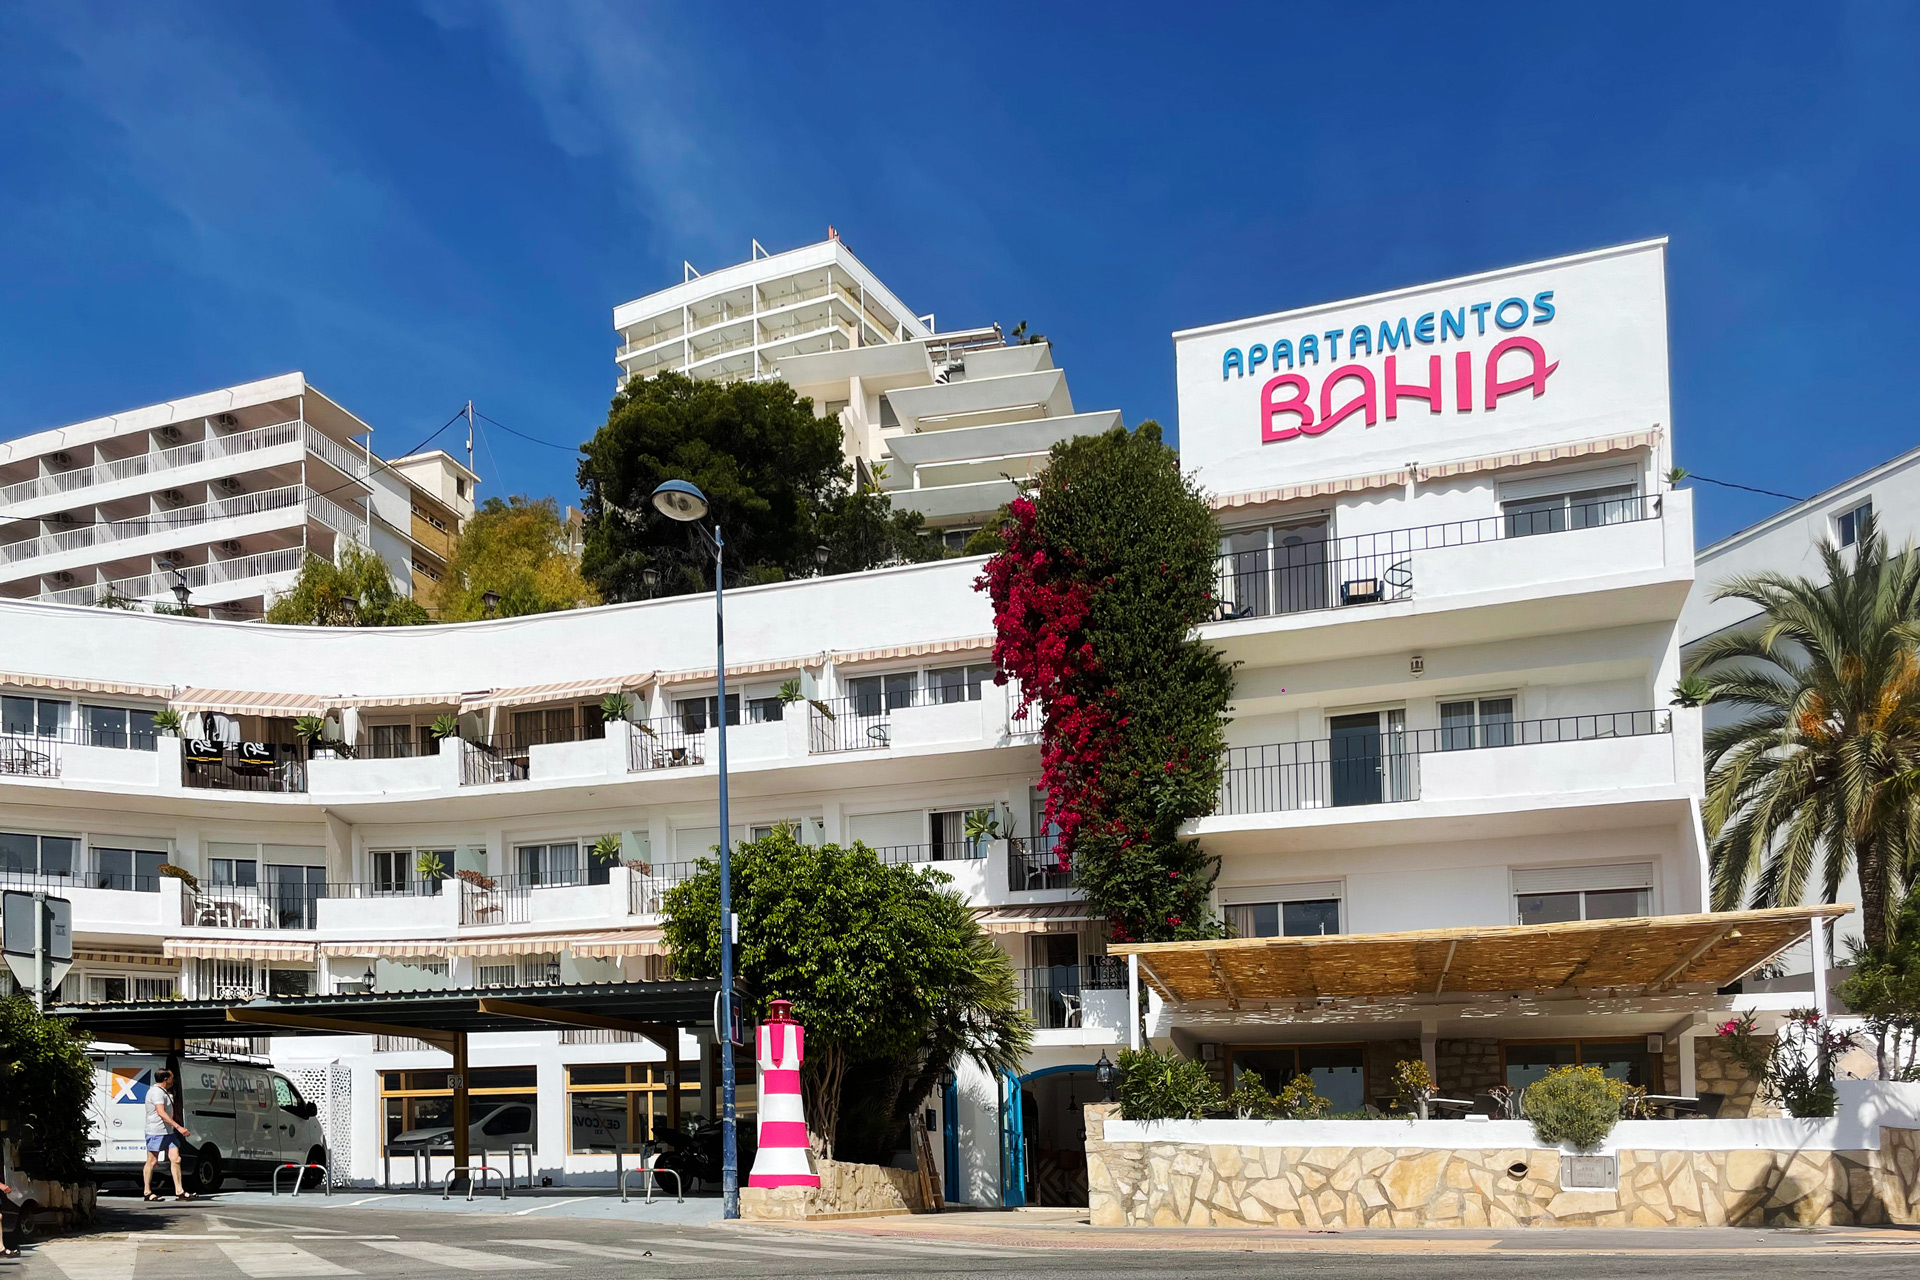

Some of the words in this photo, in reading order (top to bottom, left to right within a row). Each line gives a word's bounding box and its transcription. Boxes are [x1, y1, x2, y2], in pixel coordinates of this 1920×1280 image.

[1223, 290, 1556, 379] APARTAMENTOS
[1261, 336, 1560, 444] BAHIA
[201, 1070, 255, 1098] GEXCOVAL
